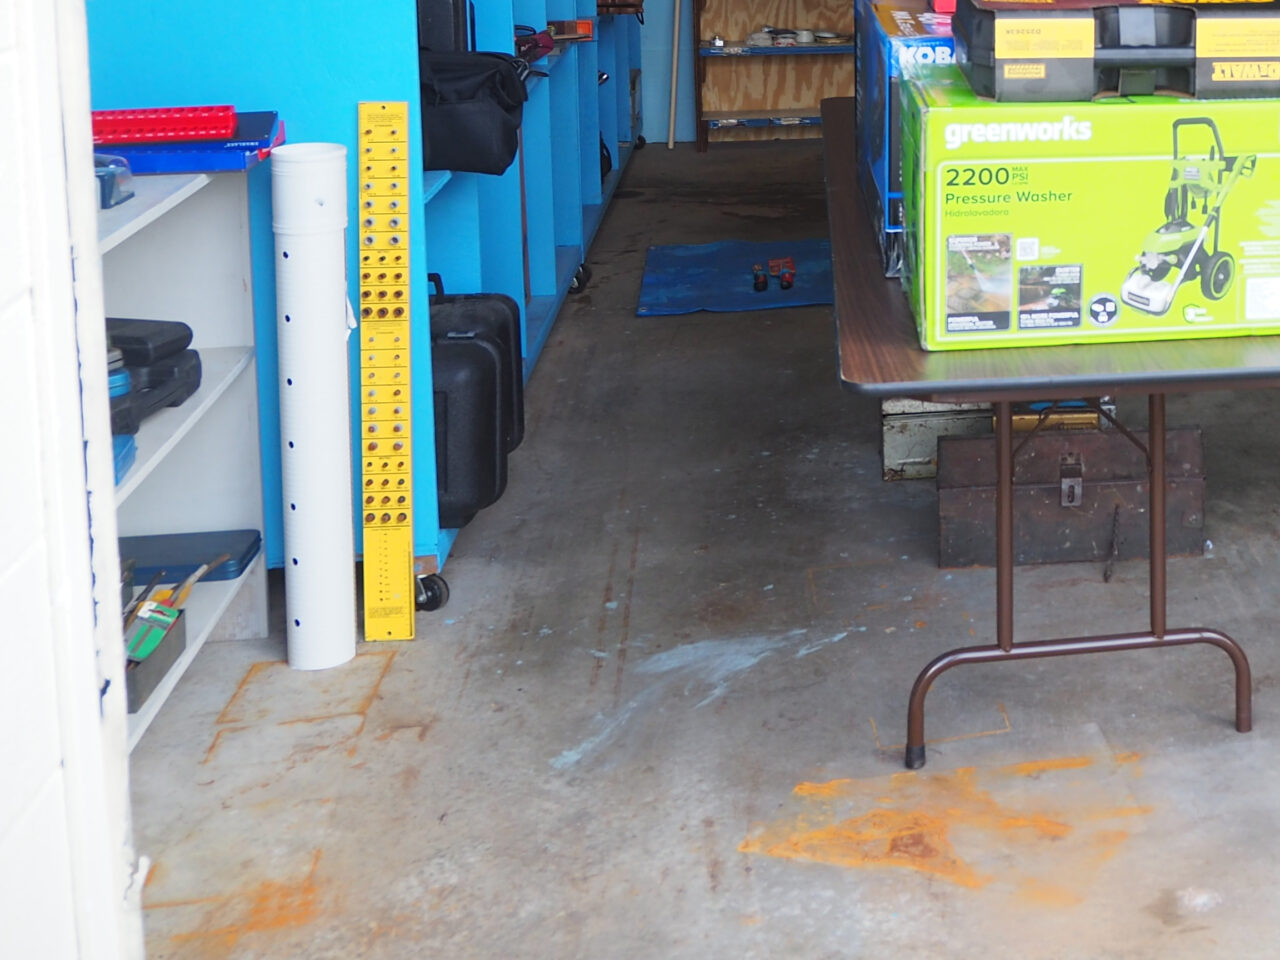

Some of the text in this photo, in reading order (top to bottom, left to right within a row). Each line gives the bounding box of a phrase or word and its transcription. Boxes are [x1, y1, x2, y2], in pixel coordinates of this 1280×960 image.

[899, 46, 956, 64] KOB
[1212, 62, 1277, 79] DEWALT
[944, 116, 1092, 150] greenworks
[946, 167, 1010, 186] 2200
[1012, 172, 1029, 181] PSI
[945, 190, 1073, 204] Pressure Washer
[945, 208, 1009, 217] Hidrolavadora
